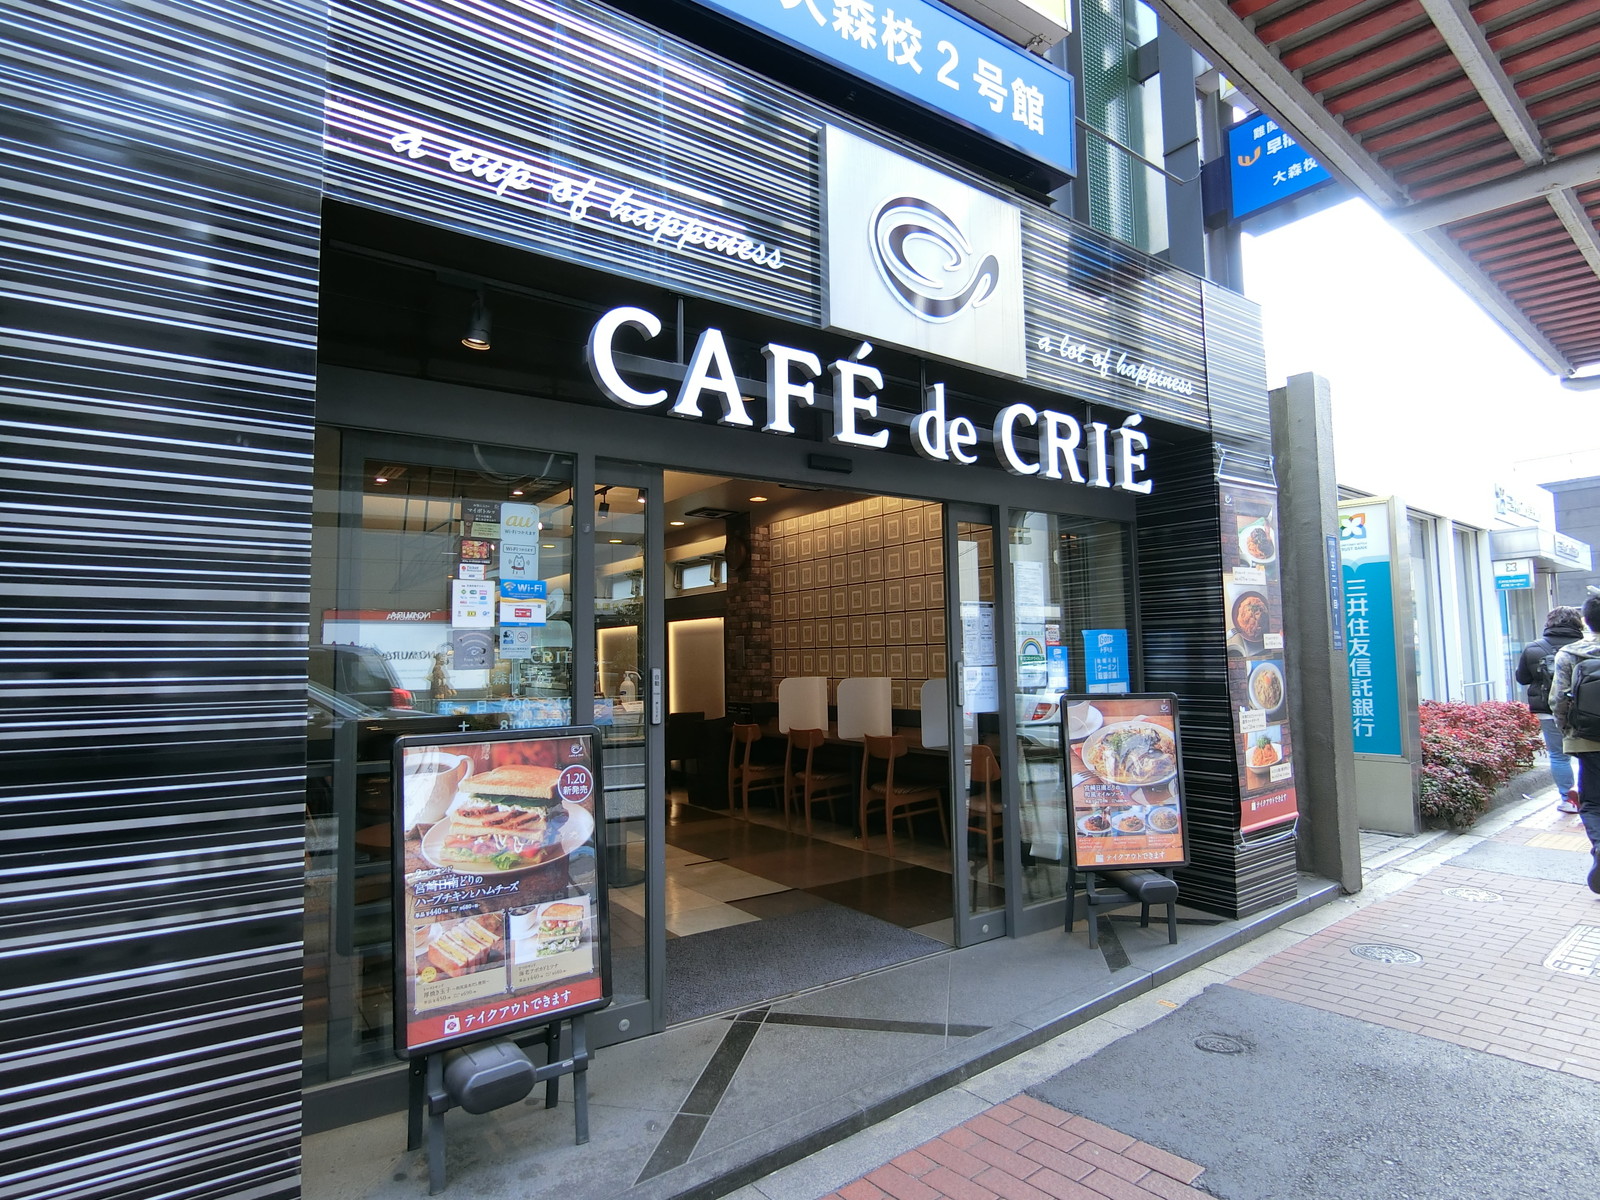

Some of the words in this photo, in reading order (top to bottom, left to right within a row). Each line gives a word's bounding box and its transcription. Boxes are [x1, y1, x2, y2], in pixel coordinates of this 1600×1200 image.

[1272, 157, 1319, 186] 大森校
[390, 132, 427, 159] a
[449, 149, 533, 197] cup
[552, 177, 597, 221] of
[609, 187, 785, 270] happiness
[1038, 336, 1053, 353] a
[1060, 334, 1087, 363] lot
[1092, 348, 1112, 377] of
[1117, 351, 1195, 396] happiness
[583, 306, 890, 450] CAFÉ
[909, 383, 978, 465] de
[992, 403, 1153, 495] CRIÉ
[505, 515, 536, 528] au
[517, 583, 543, 593] Wi-Fi
[1346, 578, 1376, 738] 三井住友信託銀行
[562, 785, 588, 796] 新発売
[566, 772, 586, 785] 1.20
[464, 989, 572, 1028] テイクアウトできます
